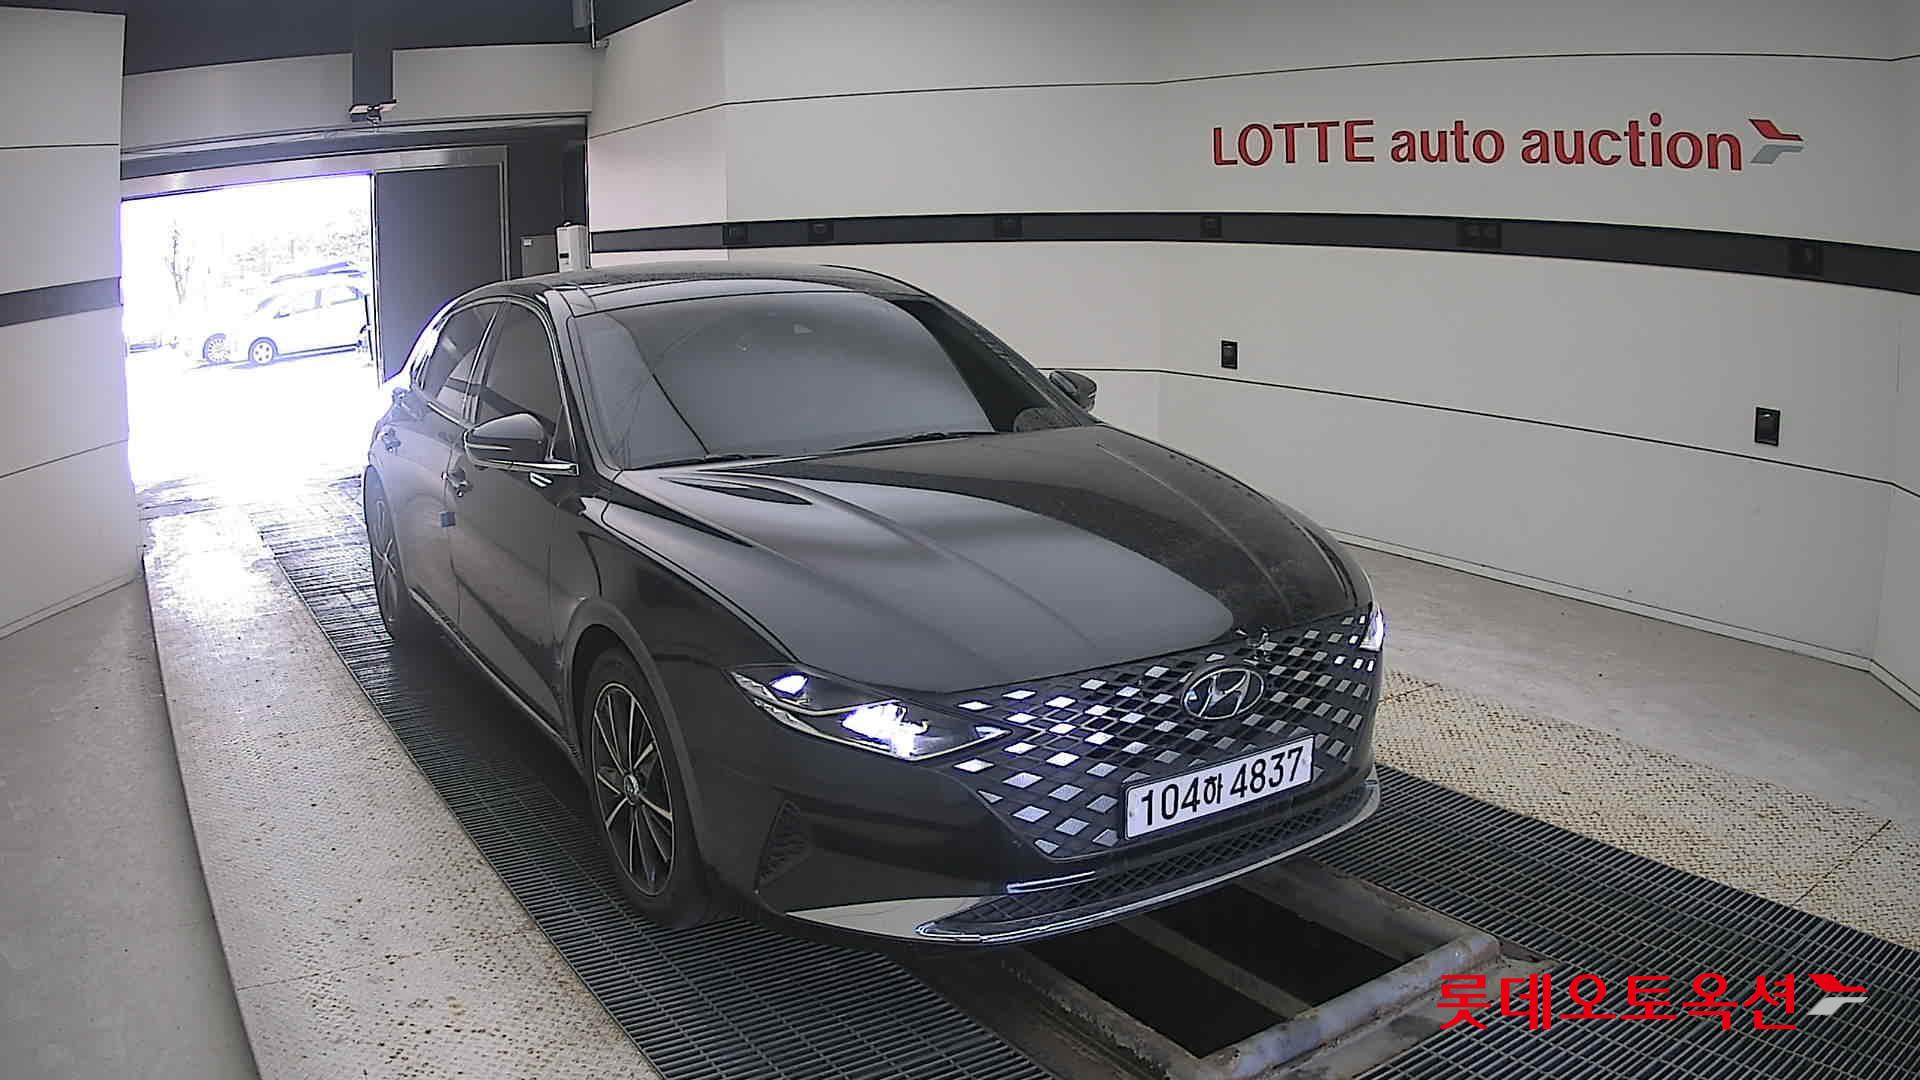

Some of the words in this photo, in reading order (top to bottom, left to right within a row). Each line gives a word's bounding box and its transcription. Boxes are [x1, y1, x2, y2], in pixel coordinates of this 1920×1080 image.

[1213, 119, 1376, 167] LOTTE
[1390, 119, 1506, 166] auto
[1521, 112, 1743, 171] auction
[1140, 772, 1224, 826] 104하
[1229, 745, 1304, 799] 4837
